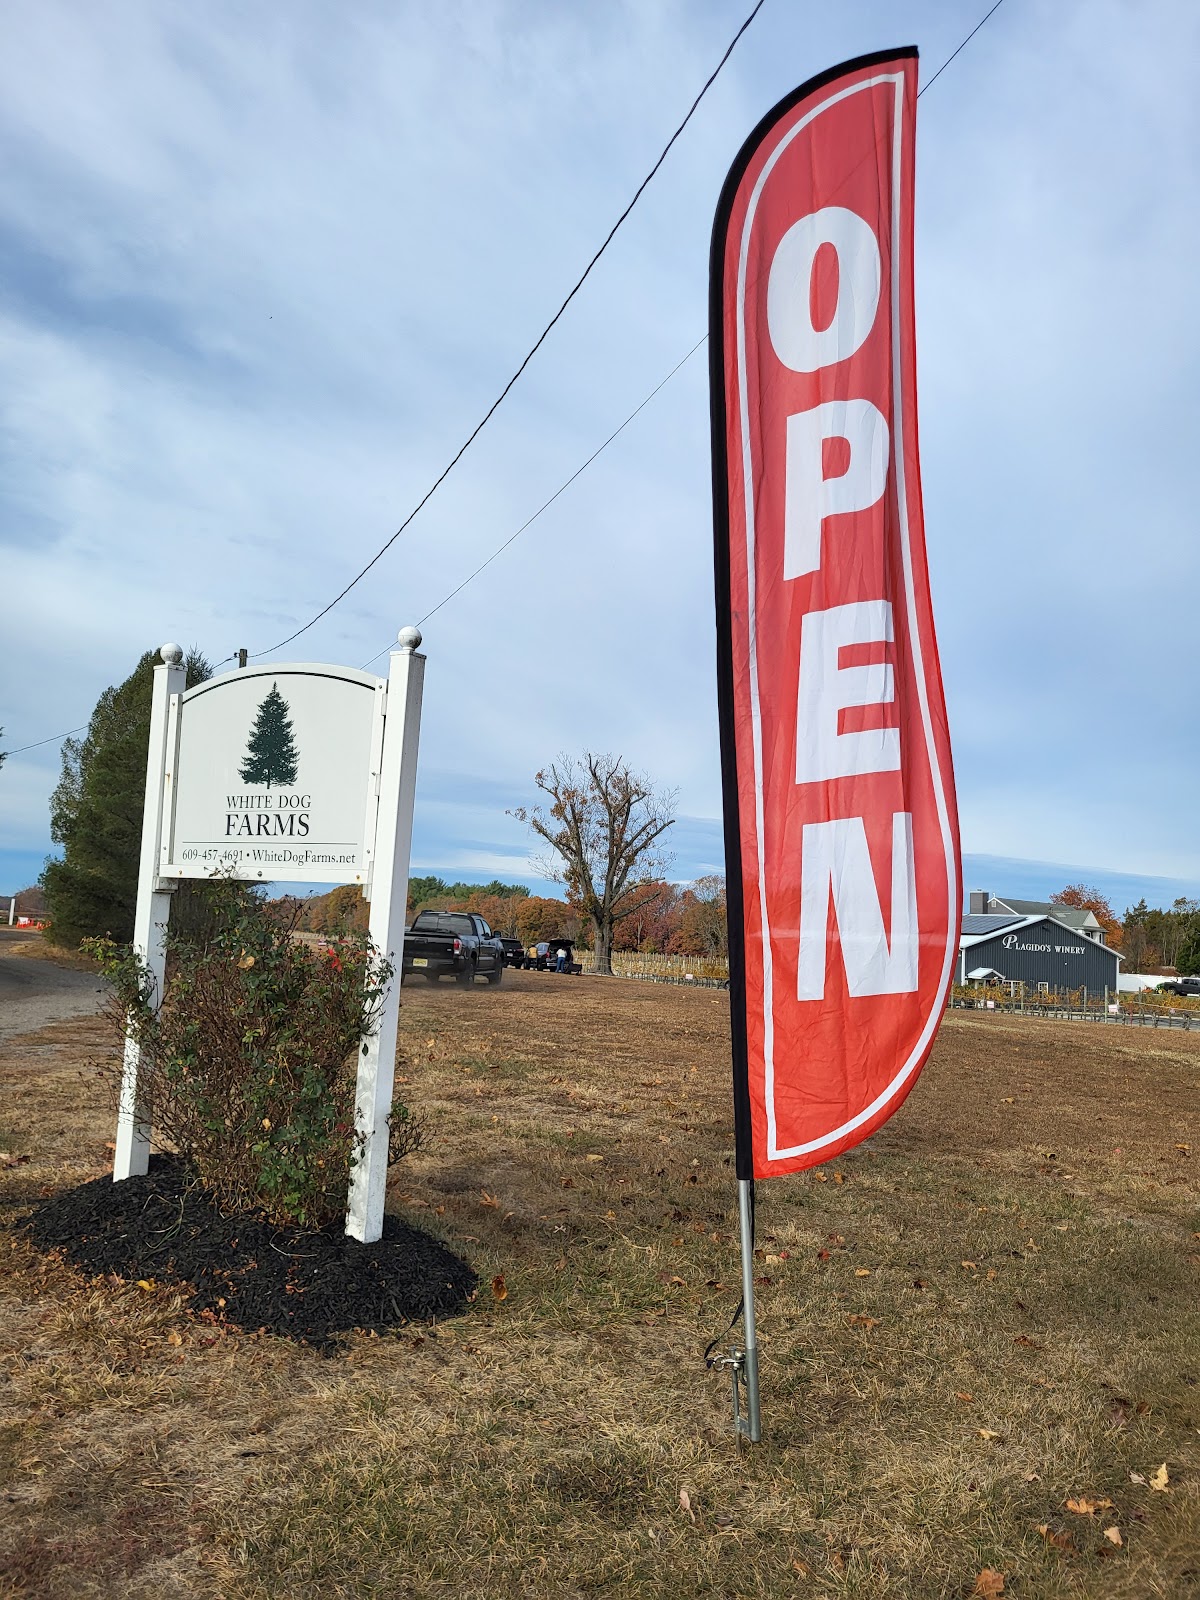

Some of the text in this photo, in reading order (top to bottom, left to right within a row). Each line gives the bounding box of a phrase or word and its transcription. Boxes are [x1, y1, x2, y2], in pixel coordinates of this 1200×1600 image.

[765, 206, 919, 1002] OPEN
[226, 794, 311, 809] WHITE DOG
[224, 814, 309, 837] FARMS
[182, 849, 356, 866] 609-457-4691 WhiteDogFarms.net
[1002, 934, 1086, 955] PLAGIDO'S WINERY
